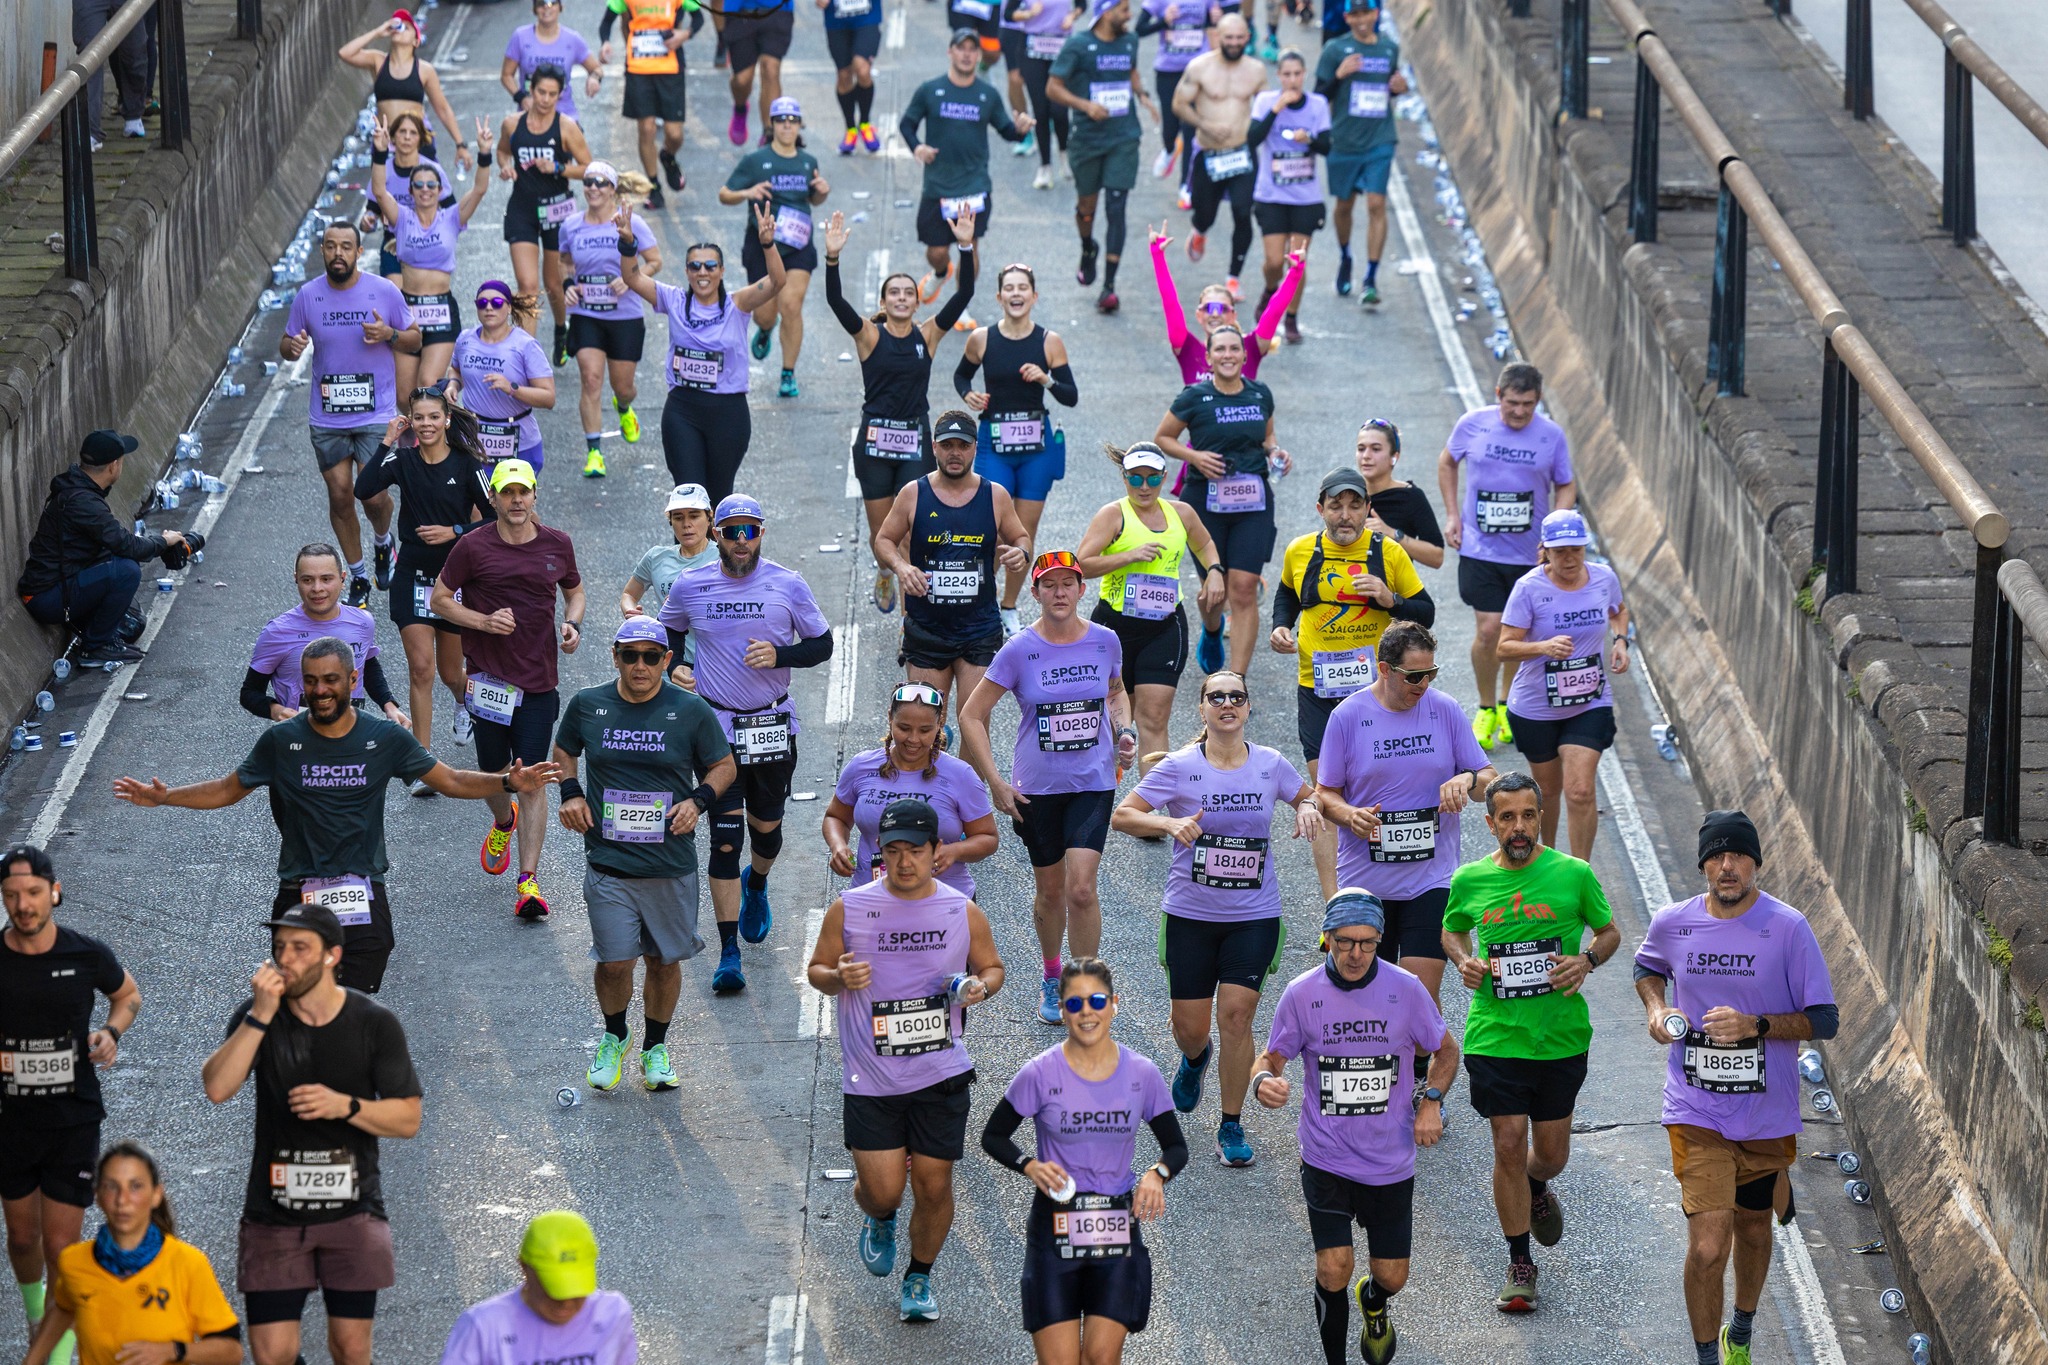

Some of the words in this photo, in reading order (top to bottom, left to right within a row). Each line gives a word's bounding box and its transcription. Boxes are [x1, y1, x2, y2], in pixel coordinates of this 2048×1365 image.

[583, 237, 617, 246] SPCITY
[330, 312, 368, 321] SPCITY
[418, 309, 447, 318] 16734
[469, 356, 505, 367] SPCITY
[478, 364, 504, 374] MARATHON
[682, 362, 716, 375] 14232
[323, 387, 328, 395] E
[334, 388, 367, 398] 14553
[1223, 405, 1261, 416] SPCITY
[1217, 414, 1264, 423] MARATHON
[869, 429, 875, 439] E
[994, 425, 999, 435] C
[1010, 426, 1034, 436] 7113
[481, 438, 511, 449] 10185
[883, 433, 915, 445] 17001
[1494, 445, 1536, 460] SPCITY
[1210, 484, 1216, 493] D
[1224, 485, 1256, 496] 25681
[1479, 504, 1484, 513] D
[1491, 507, 1528, 517] 10434
[938, 576, 976, 587] 12243
[1128, 586, 1135, 596] D
[1141, 589, 1175, 603] 24668
[716, 602, 765, 613] SPCITY
[1564, 608, 1604, 622] SPCITY
[1329, 622, 1378, 634] SALGADOS
[1574, 619, 1605, 628] MARATHON
[1051, 665, 1099, 679] SPCITY
[1315, 666, 1321, 677] D
[1328, 664, 1368, 679] 24549
[1042, 679, 1060, 687] HALF
[1062, 675, 1100, 684] MARATHON
[1549, 675, 1555, 686] D
[1563, 672, 1598, 687] 12453
[469, 681, 474, 692] E
[481, 688, 509, 706] 26111
[759, 715, 777, 723] SPCITY
[1056, 717, 1098, 732] 10280
[1041, 722, 1048, 730] D
[614, 730, 665, 742] SPCITY
[737, 732, 744, 742] F
[752, 730, 786, 745] 18626
[602, 741, 665, 752] MARATHON
[1384, 734, 1432, 751] SPCITY
[1374, 752, 1392, 760] HALF
[1395, 747, 1434, 757] MARATHON
[311, 764, 367, 778] SPCITY
[302, 776, 367, 787] MARATHON
[1212, 793, 1263, 805] SPCITY
[606, 806, 612, 816] C
[620, 809, 662, 822] 22729
[1395, 811, 1418, 819] SPCITY
[1372, 828, 1379, 838] E
[1388, 826, 1431, 842] 16705
[1197, 850, 1204, 860] F
[1214, 854, 1256, 869] 18140
[322, 891, 365, 905] 26592
[889, 930, 948, 944] SPCITY
[878, 944, 899, 952] HALF
[901, 943, 947, 951] MARATHON
[1513, 941, 1538, 950] SPCITY
[1698, 953, 1756, 968] SPCITY
[1492, 962, 1498, 973] E
[1506, 958, 1554, 976] 16266
[1686, 968, 1706, 976] HALF
[1709, 968, 1756, 977] MARATHON
[902, 998, 927, 1007] SPCITY
[878, 1019, 886, 1034] E
[895, 1016, 942, 1035] 16010
[1333, 1020, 1388, 1036] SPCITY
[908, 1033, 932, 1041] LEANDRO
[1323, 1038, 1342, 1046] HALF
[1345, 1036, 1389, 1044] MARATHON
[1687, 1050, 1695, 1062] F
[4, 1056, 11, 1069] E
[20, 1057, 70, 1074] 15368
[1703, 1055, 1754, 1070] 18625
[1323, 1077, 1330, 1087] F
[1342, 1076, 1387, 1092] 17631
[1072, 1110, 1131, 1125] SPCITY
[1060, 1126, 1083, 1134] HALF
[1085, 1126, 1132, 1134] MARATHON
[276, 1168, 283, 1182] E
[295, 1171, 346, 1187] 17287
[1085, 1196, 1111, 1204] SPCITY
[1058, 1215, 1066, 1231] E
[1075, 1217, 1127, 1234] 16052
